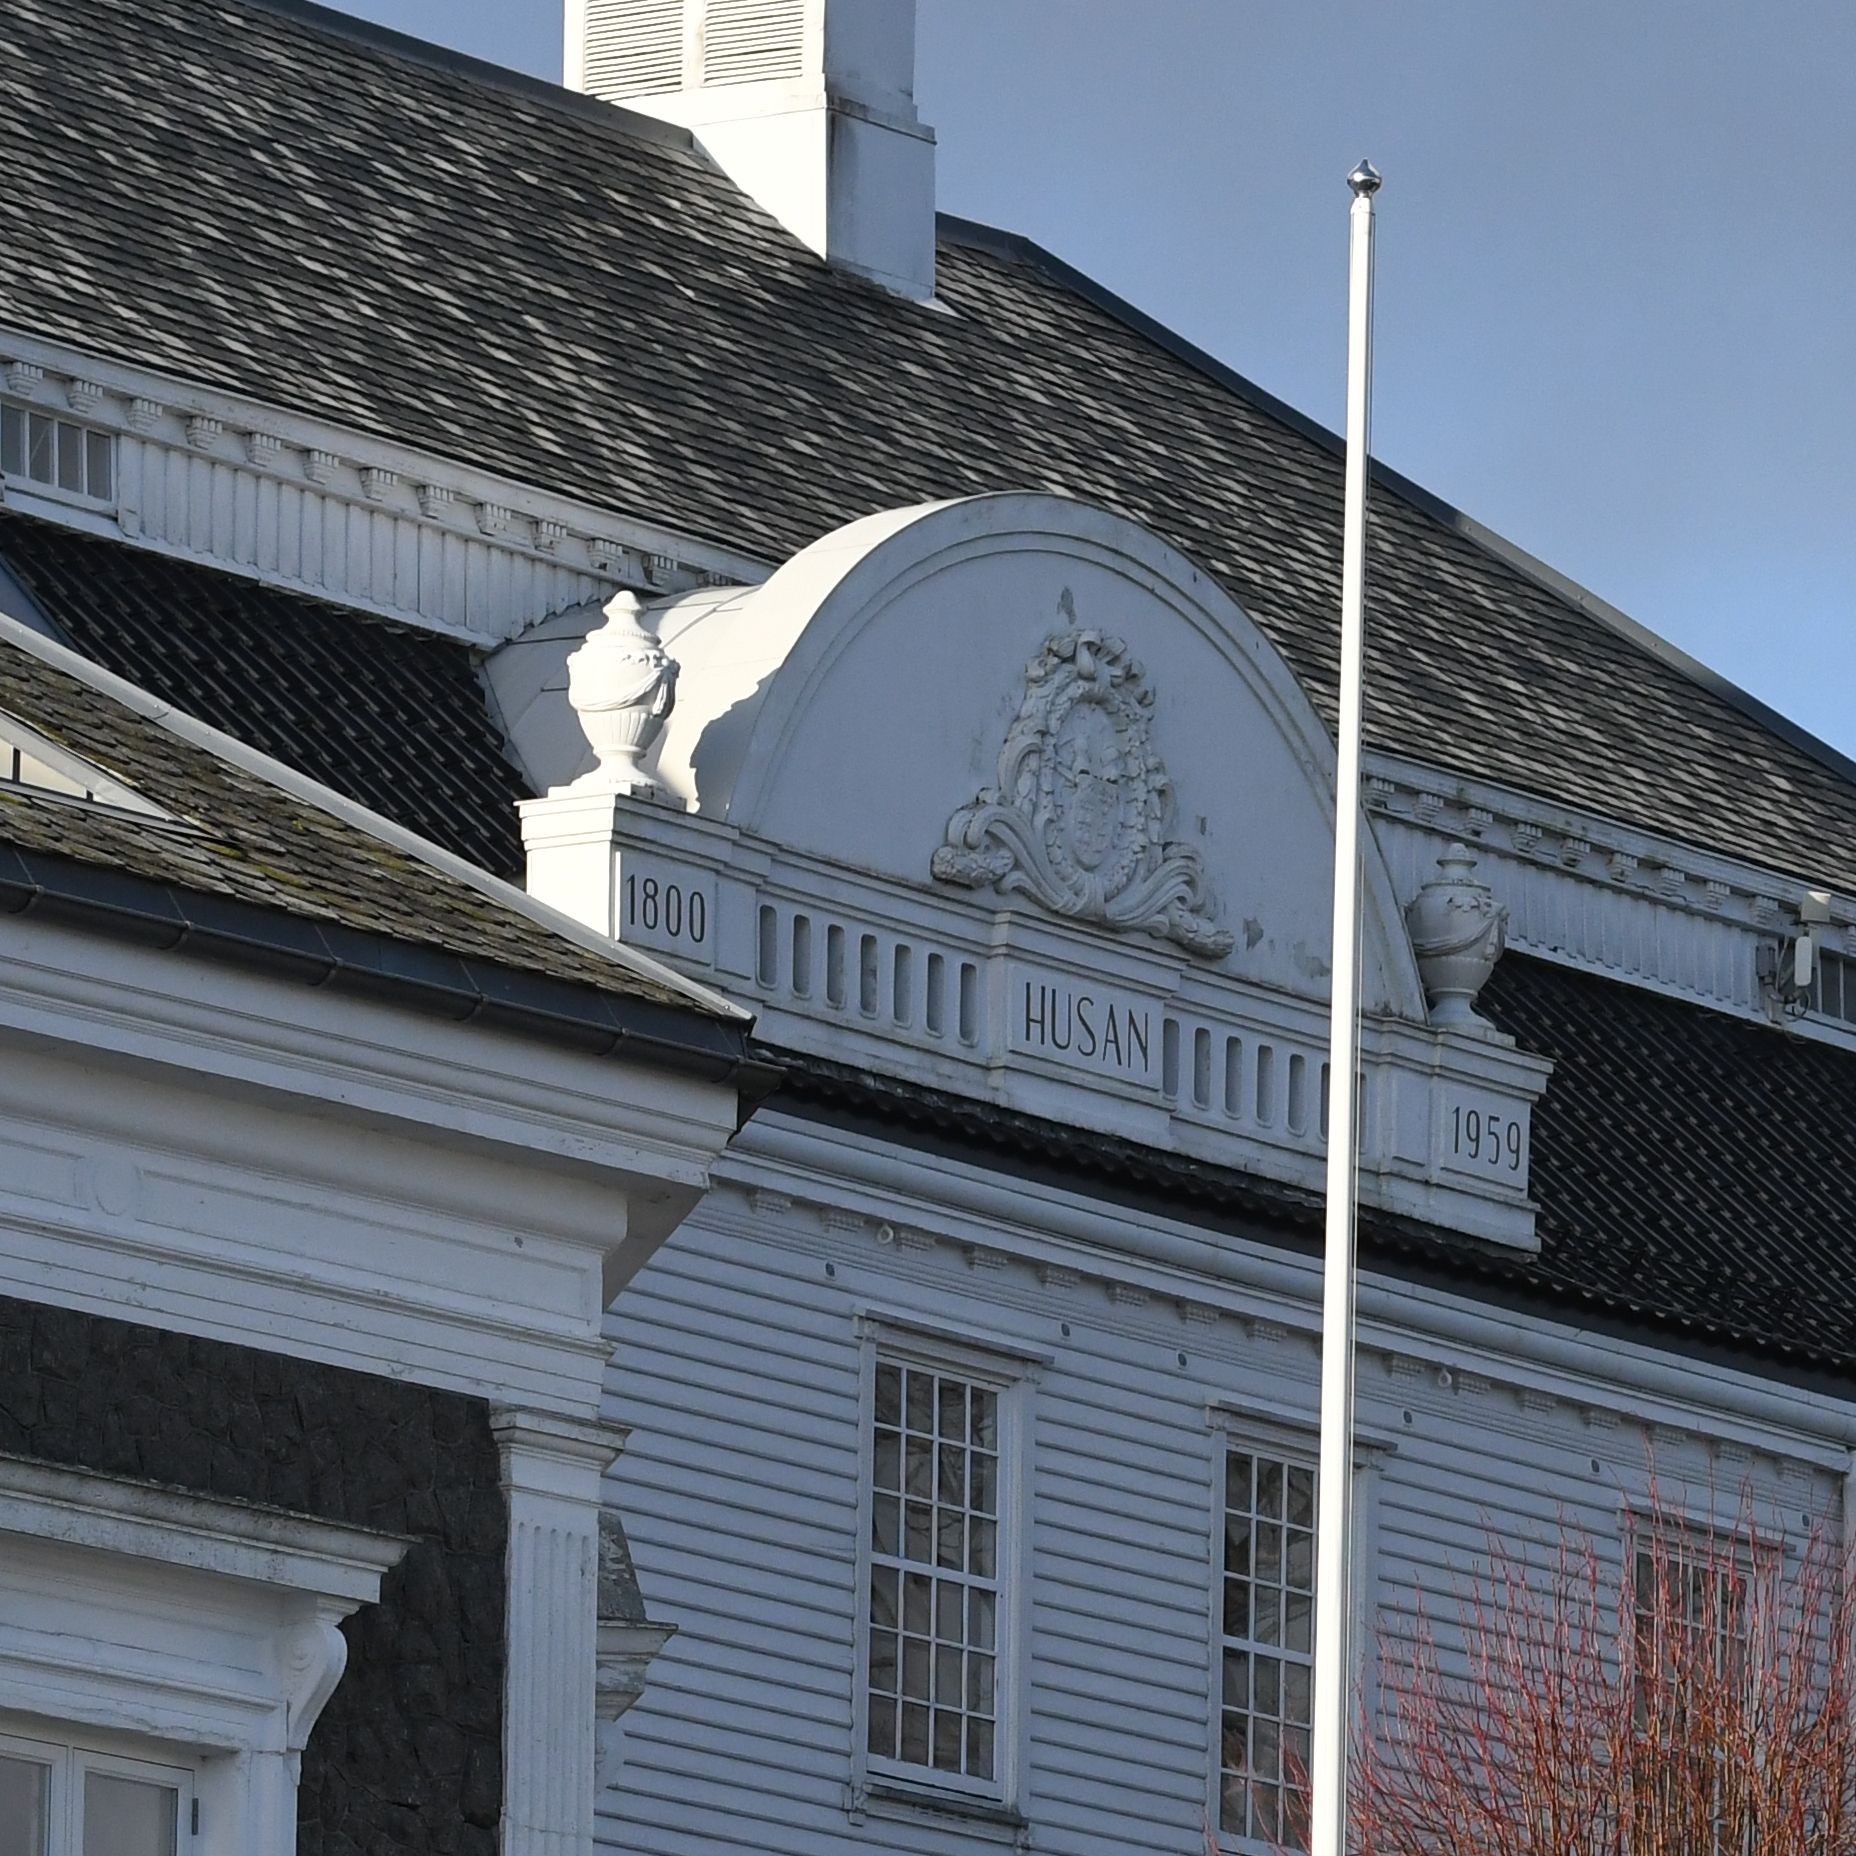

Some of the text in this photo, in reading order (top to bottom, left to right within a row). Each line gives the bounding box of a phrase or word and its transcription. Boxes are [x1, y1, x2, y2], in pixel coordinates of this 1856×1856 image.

[626, 873, 706, 943] 1800
[1025, 981, 1149, 1073] HUSAN
[1452, 1106, 1521, 1171] 1959
